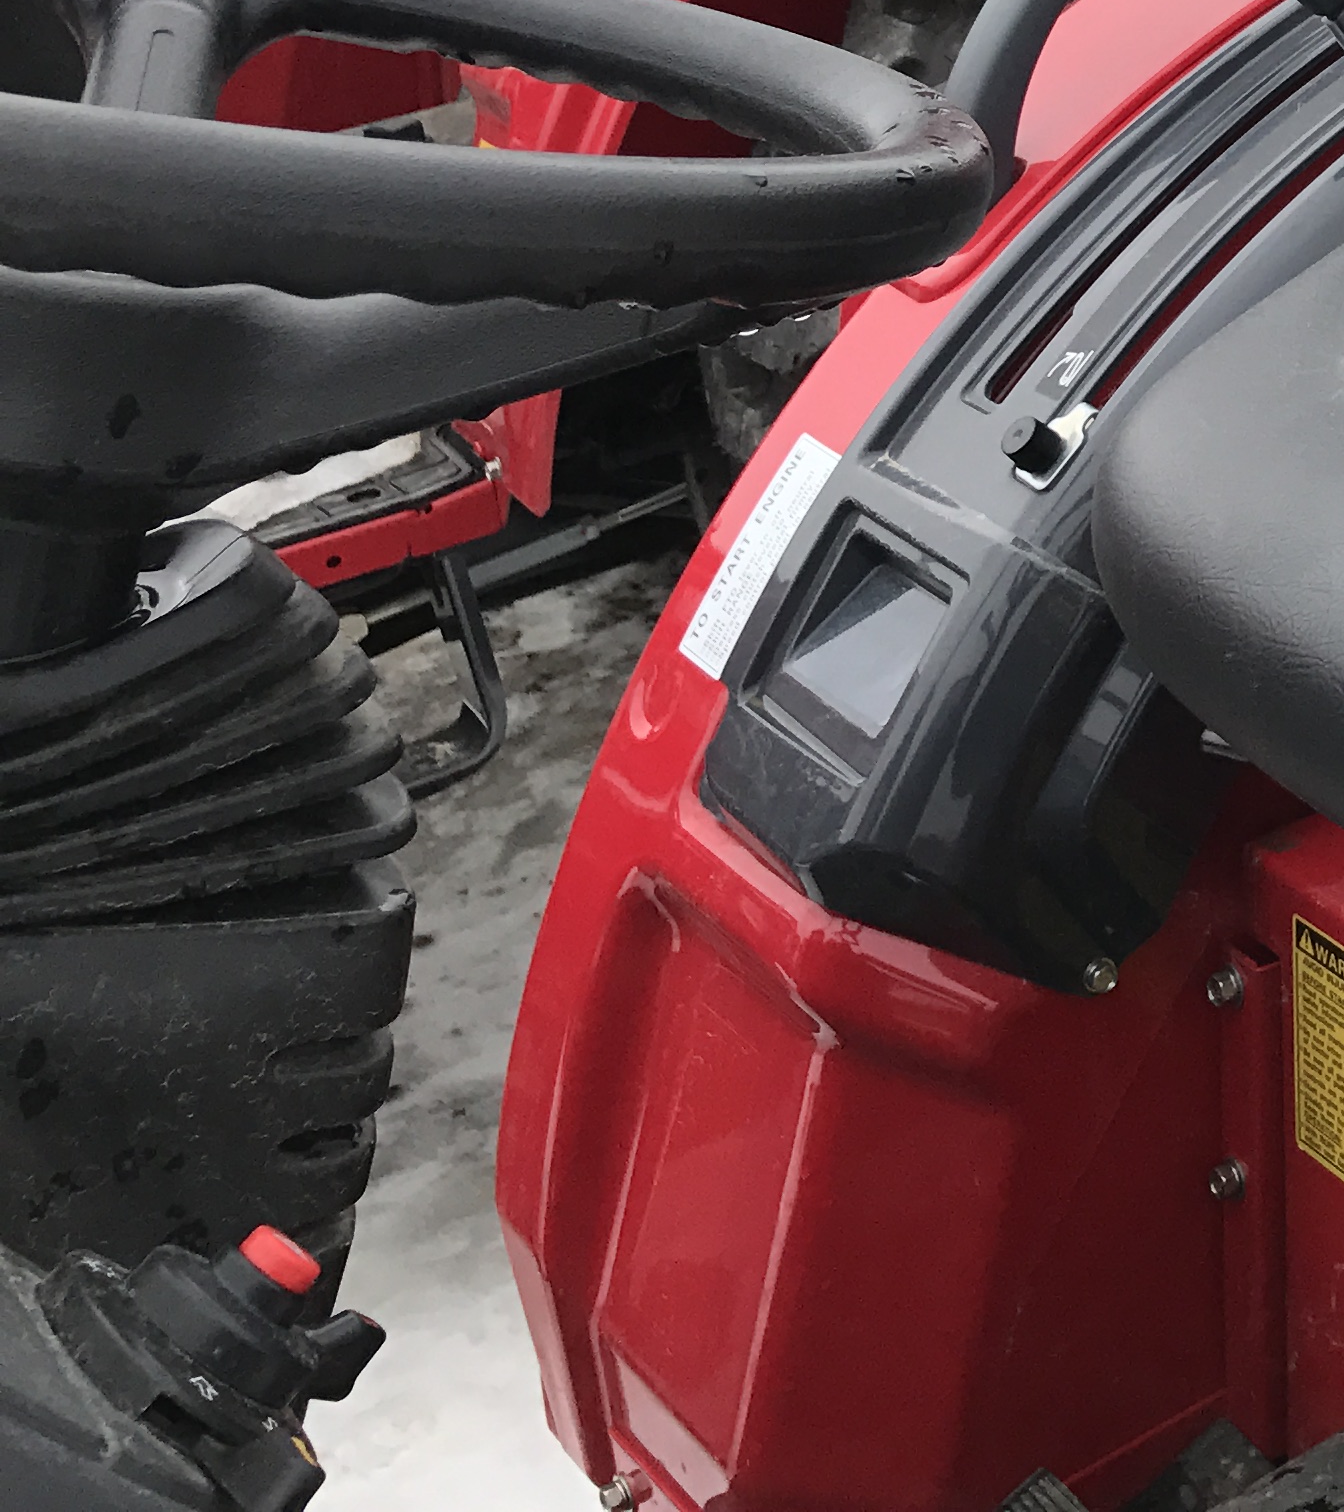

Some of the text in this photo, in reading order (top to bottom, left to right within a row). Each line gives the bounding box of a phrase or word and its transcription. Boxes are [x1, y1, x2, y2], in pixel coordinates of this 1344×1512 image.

[690, 449, 807, 639] TO START ENGINE
